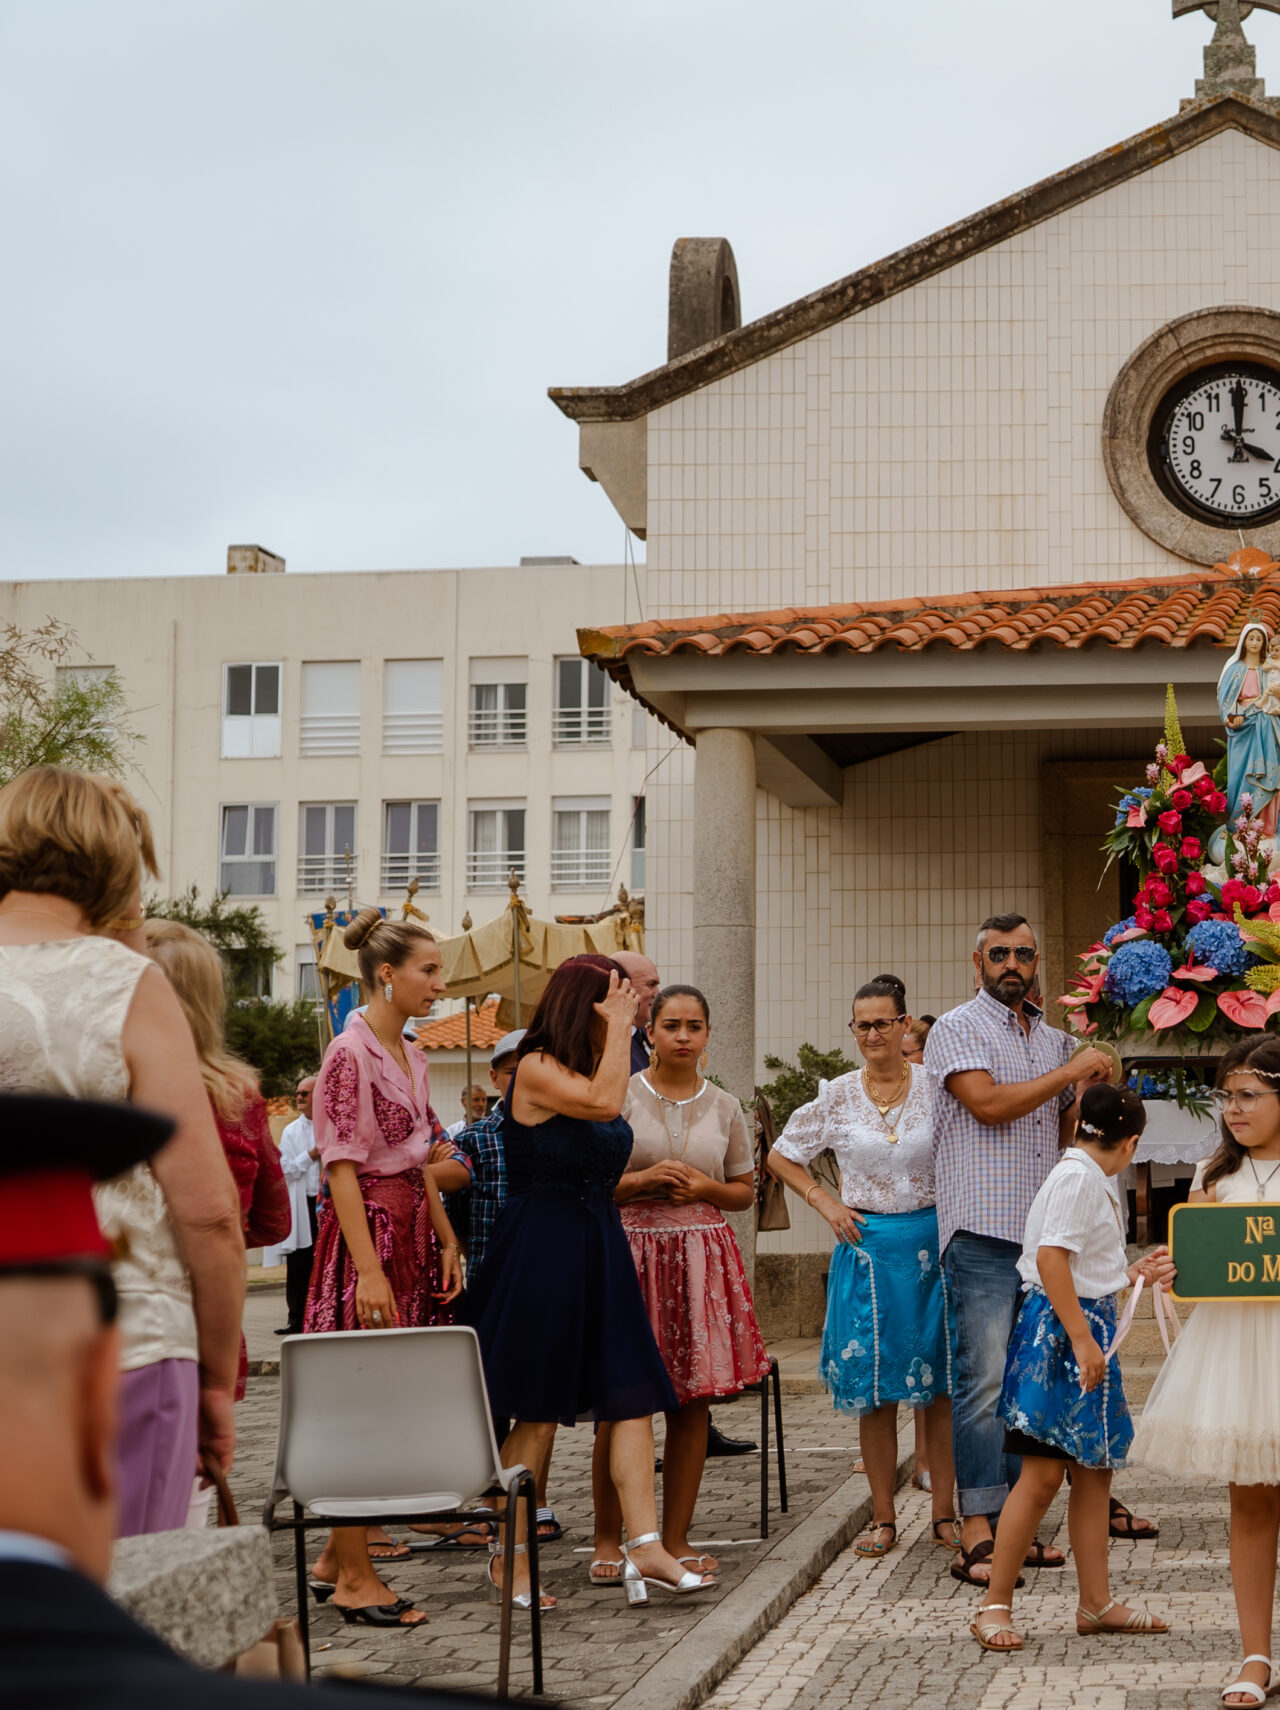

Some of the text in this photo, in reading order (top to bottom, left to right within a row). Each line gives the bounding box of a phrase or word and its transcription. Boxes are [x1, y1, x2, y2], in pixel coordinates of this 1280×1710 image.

[1205, 392, 1220, 412] 11
[1259, 391, 1265, 412] 1
[1186, 412, 1204, 431] 10
[1183, 436, 1195, 455] 9
[1190, 459, 1202, 479] 8
[1210, 478, 1222, 498] 7
[1233, 485, 1245, 504] 6
[1259, 478, 1271, 498] 5
[1227, 1261, 1255, 1283] DO
